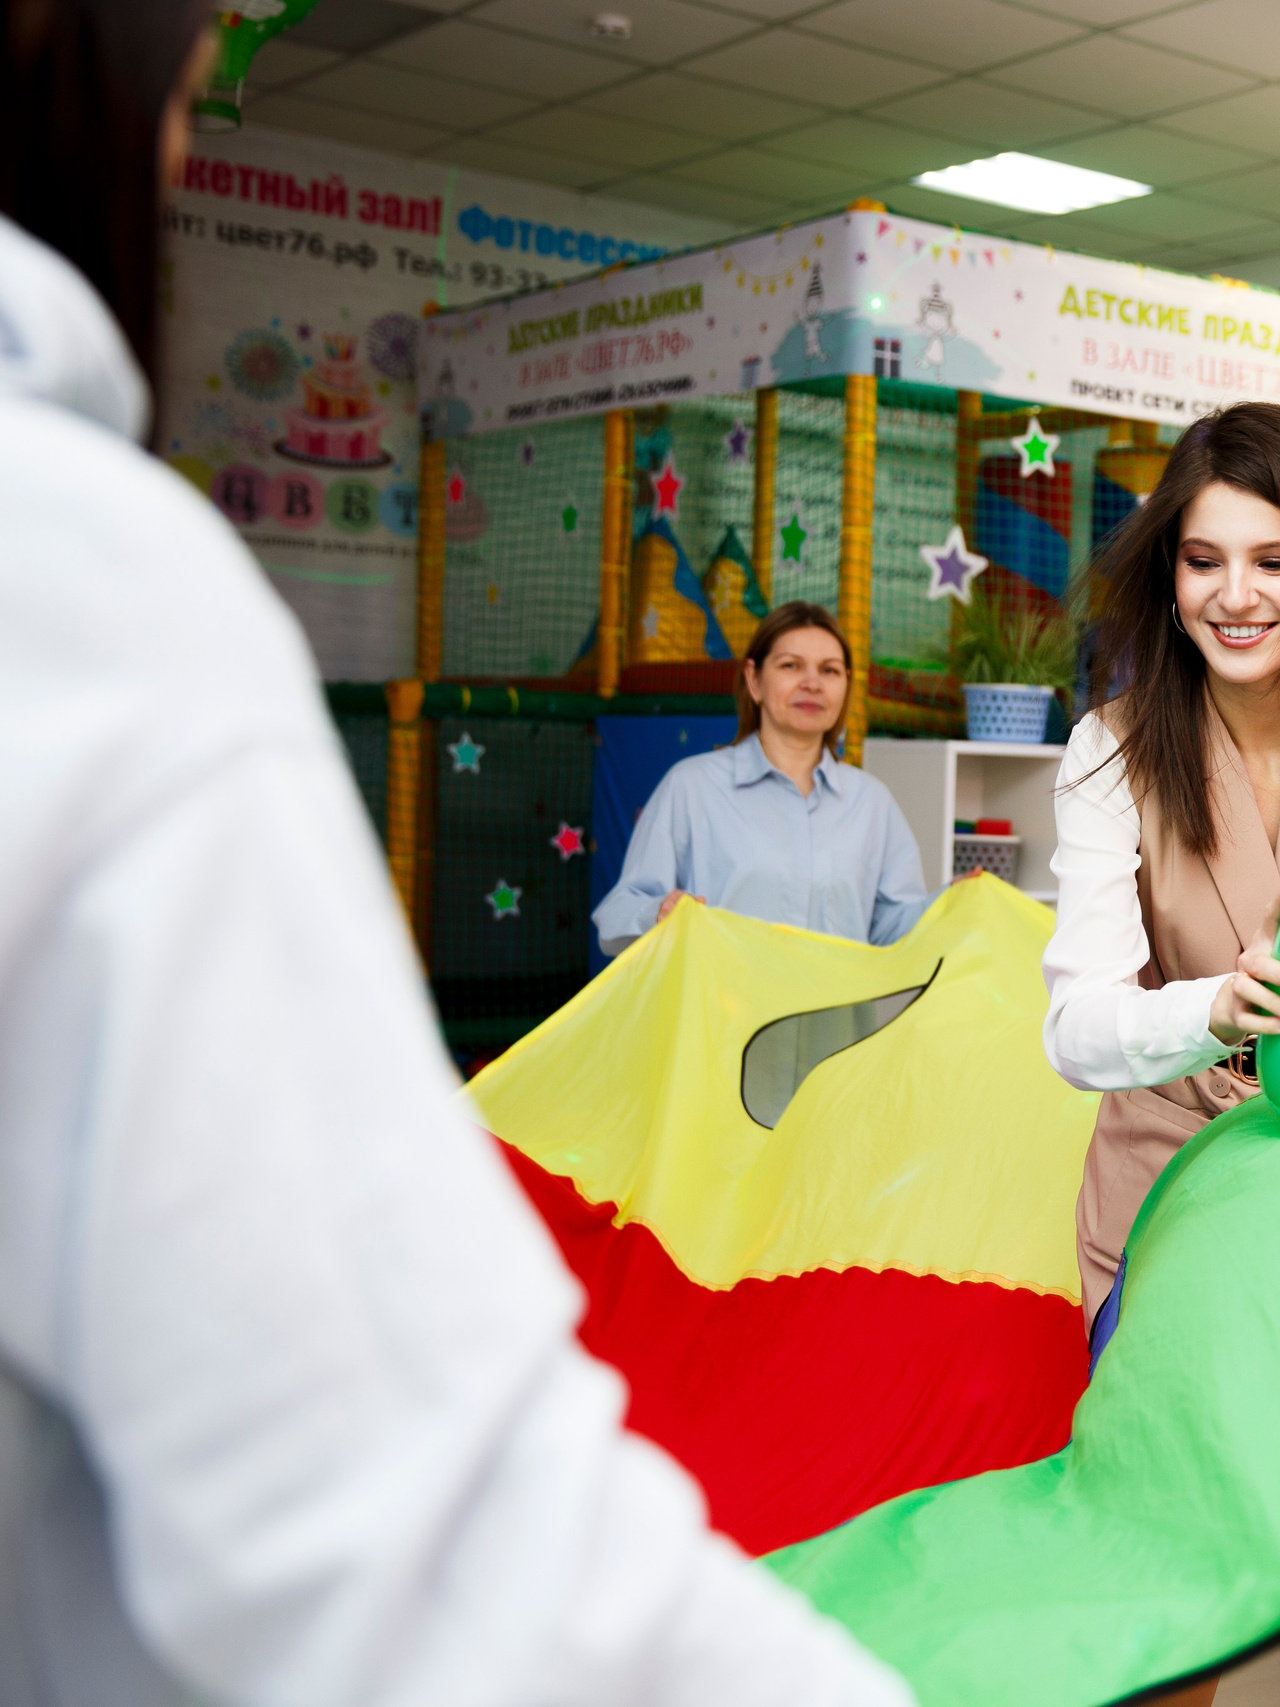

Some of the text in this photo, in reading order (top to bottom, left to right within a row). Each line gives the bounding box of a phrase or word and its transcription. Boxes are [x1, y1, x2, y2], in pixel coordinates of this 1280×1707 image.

[356, 188, 444, 238] зал!
[216, 220, 379, 274] цвет76.рф
[507, 283, 704, 355] ДЕТСКИЕ ПРАЗДНИКИ
[1058, 284, 1191, 336] ДЕТСКИЕ
[1082, 336, 1099, 366] В
[1105, 341, 1176, 380] ЗАЛЕ
[1069, 377, 1136, 402] ПРОЕКТ
[1142, 393, 1186, 413] СЕТИ
